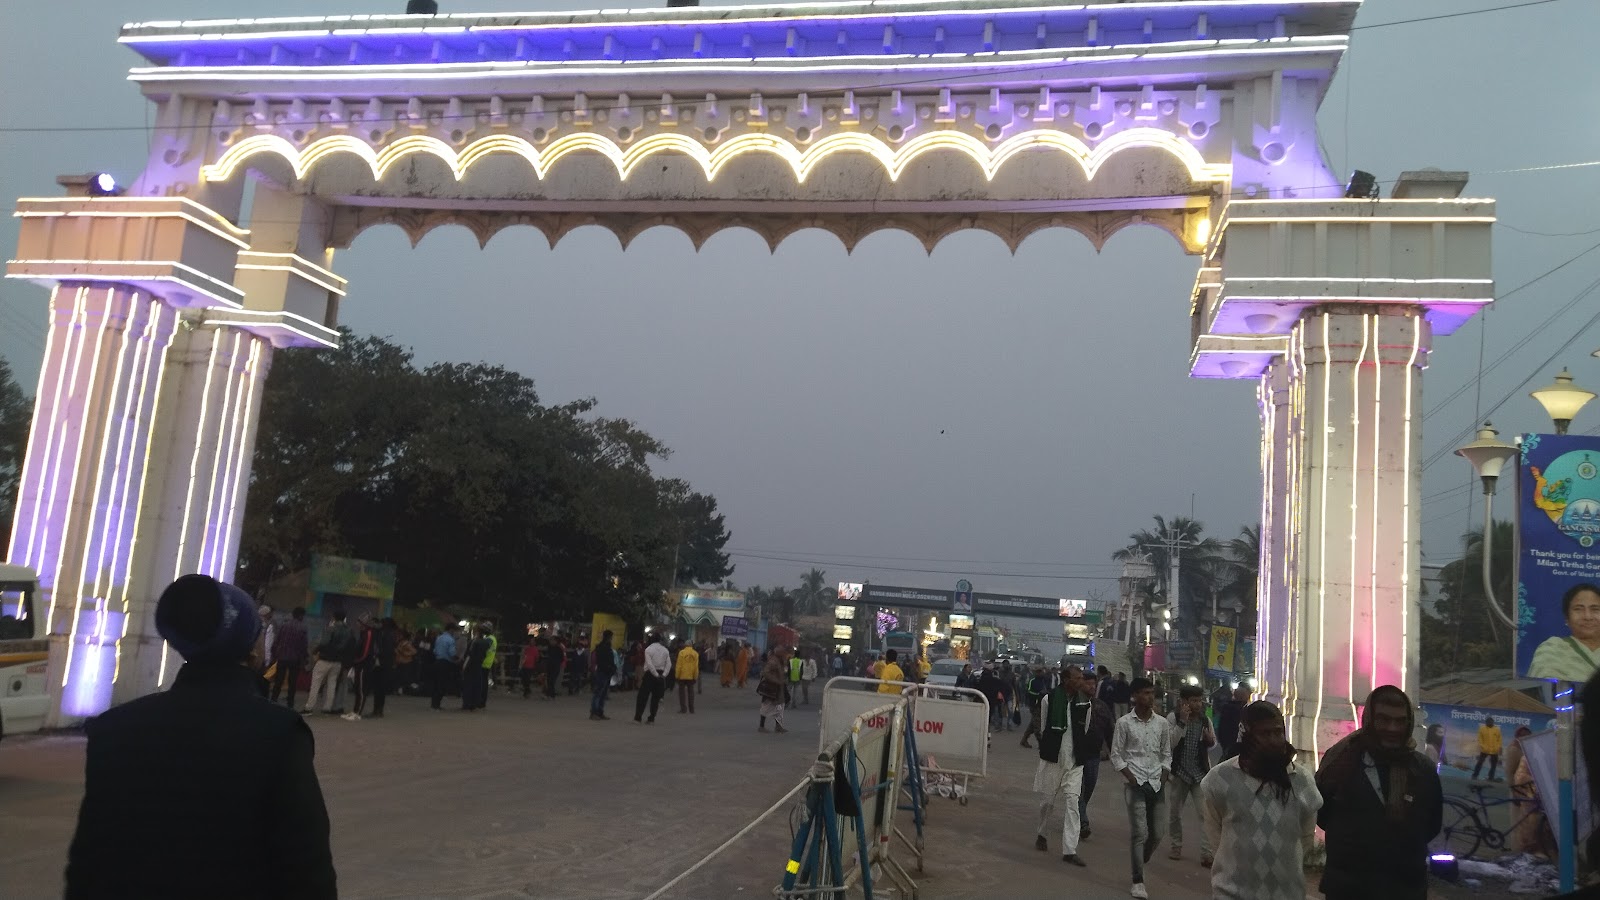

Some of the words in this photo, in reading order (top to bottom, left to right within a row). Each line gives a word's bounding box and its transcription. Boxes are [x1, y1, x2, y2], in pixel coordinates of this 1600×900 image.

[1558, 524, 1600, 533] GANGASA
[1530, 549, 1555, 558] Thank
[1572, 552, 1585, 560] for
[1537, 559, 1559, 567] Milan
[916, 720, 944, 734] LOW
